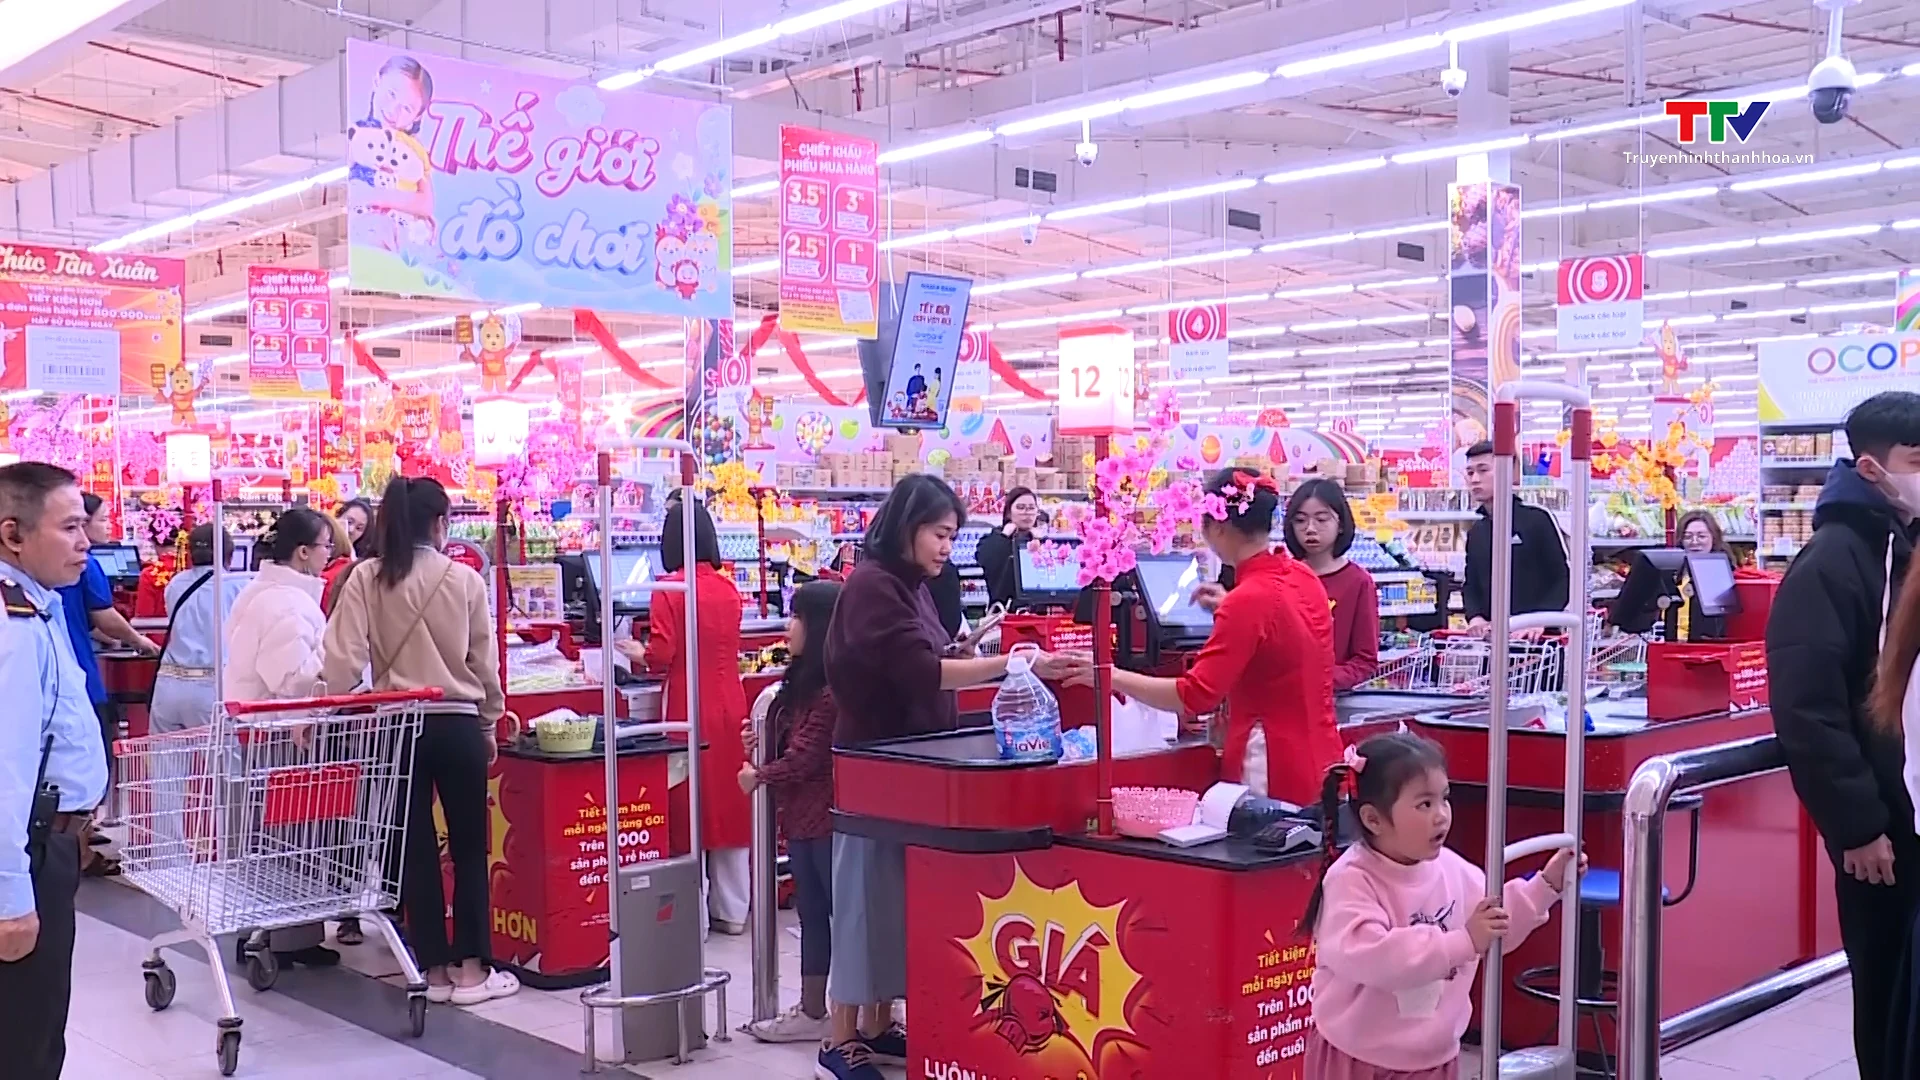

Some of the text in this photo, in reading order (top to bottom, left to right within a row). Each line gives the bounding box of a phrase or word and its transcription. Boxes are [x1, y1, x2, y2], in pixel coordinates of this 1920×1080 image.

[428, 91, 660, 198] Thế giới
[798, 141, 862, 160] CHIẾT KHẤU
[784, 156, 875, 177] PHIẾU MUA HÀNG
[440, 177, 651, 275] đồ chơi
[53, 251, 96, 277] Tân
[101, 256, 160, 282] Xuân
[1191, 314, 1204, 335] 4
[1808, 340, 1920, 375] OCOP
[1071, 365, 1101, 398] 12
[1119, 367, 1130, 398] 12
[755, 461, 765, 474] 7
[579, 806, 601, 818] Tiết
[631, 802, 651, 813] hơn
[564, 822, 585, 836] mỗi
[645, 815, 665, 826] GO!
[579, 840, 605, 852] Trên
[639, 849, 660, 860] hơn
[493, 906, 538, 945] HƠN
[991, 913, 1111, 1020] GIÁ
[1257, 949, 1280, 968] Tiết
[1242, 975, 1264, 995] mỗi
[1266, 970, 1293, 989] ngày
[1257, 998, 1284, 1018] Trên
[1247, 1025, 1268, 1045] sản
[1271, 1014, 1302, 1041] phẩm
[1257, 1036, 1305, 1067] đến cuối
